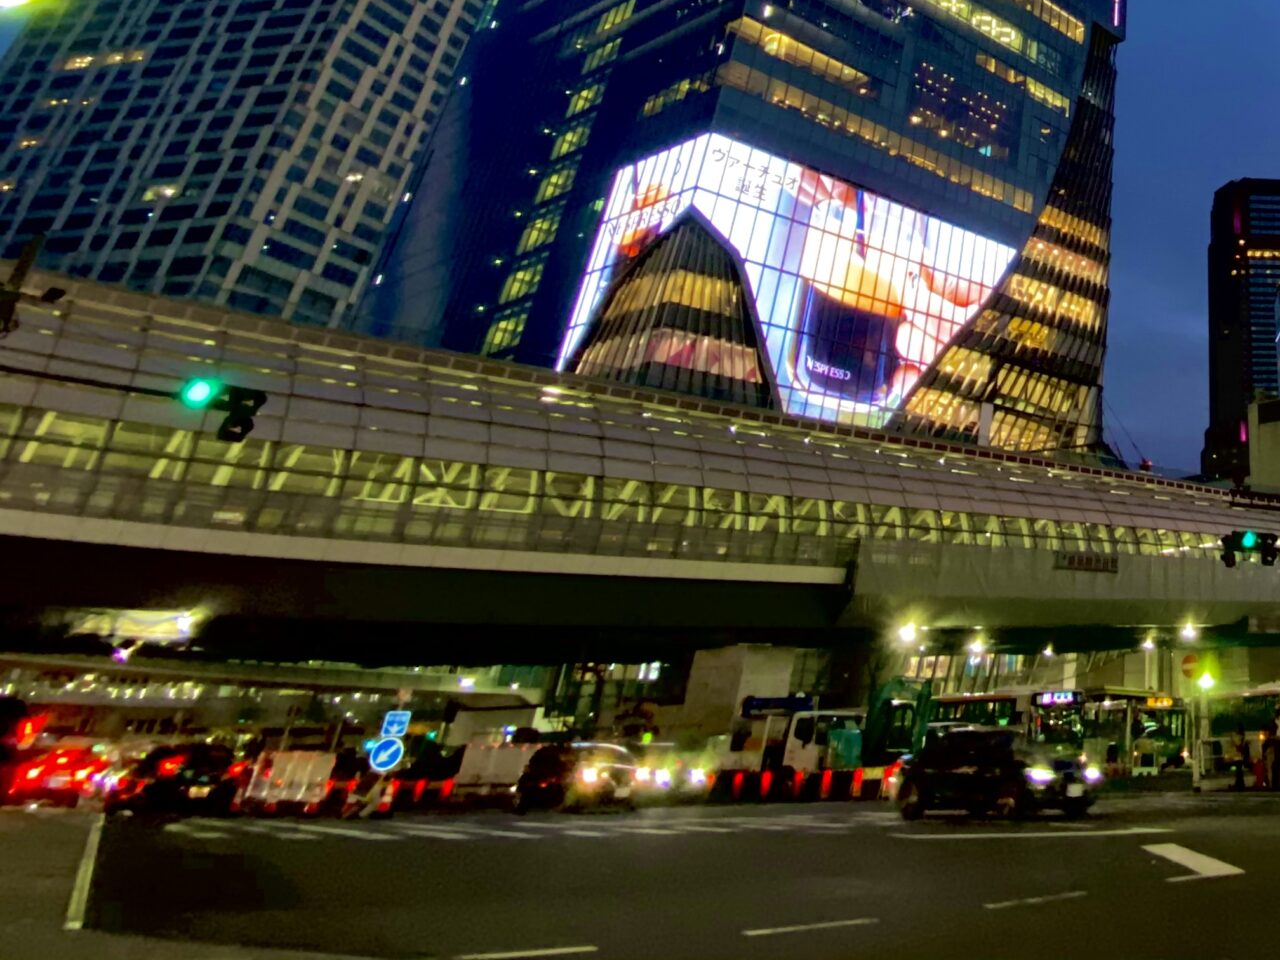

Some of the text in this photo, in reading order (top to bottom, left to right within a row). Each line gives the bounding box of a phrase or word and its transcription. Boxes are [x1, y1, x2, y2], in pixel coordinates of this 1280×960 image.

[711, 147, 799, 190] ヴァーチュオ
[735, 176, 767, 202] 誕生
